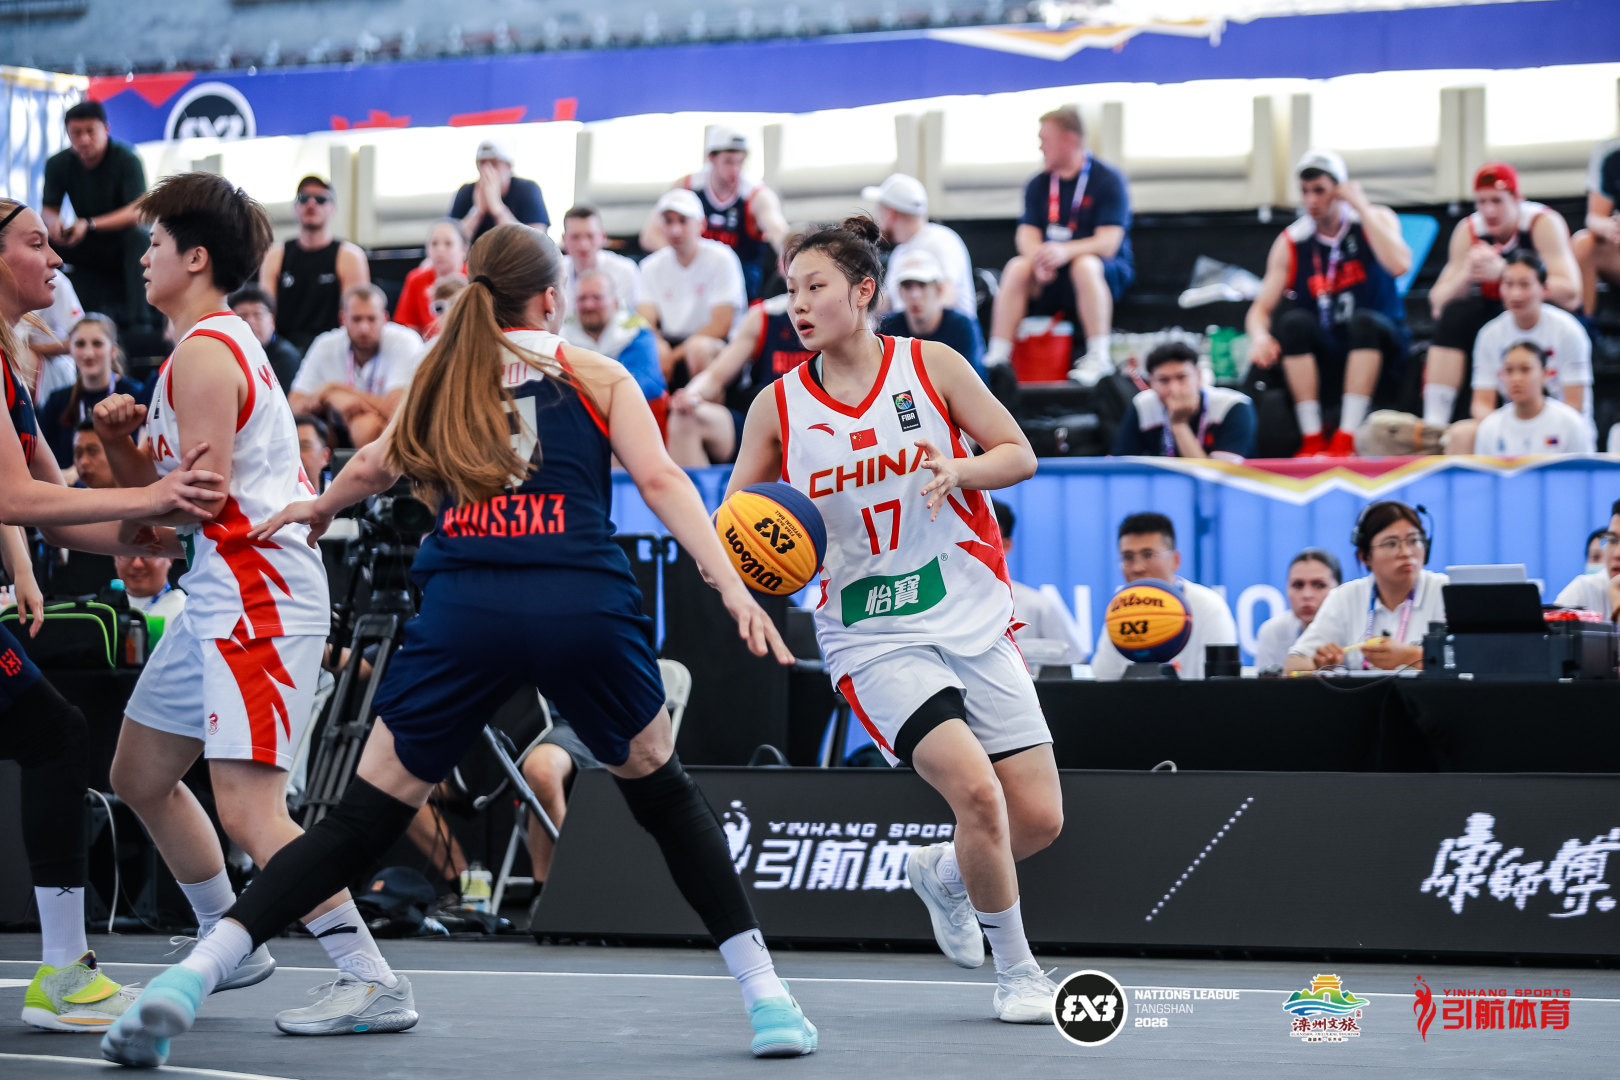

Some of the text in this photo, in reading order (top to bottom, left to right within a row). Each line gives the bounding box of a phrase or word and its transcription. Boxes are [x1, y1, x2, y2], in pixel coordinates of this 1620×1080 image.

[901, 412, 916, 422] FIBA
[754, 517, 796, 554] 3X3
[861, 498, 902, 556] 17
[725, 523, 783, 592] Wilson
[865, 574, 921, 616] 怡寶
[768, 822, 957, 838] YINHANG SPOR
[753, 838, 955, 892] 引航体
